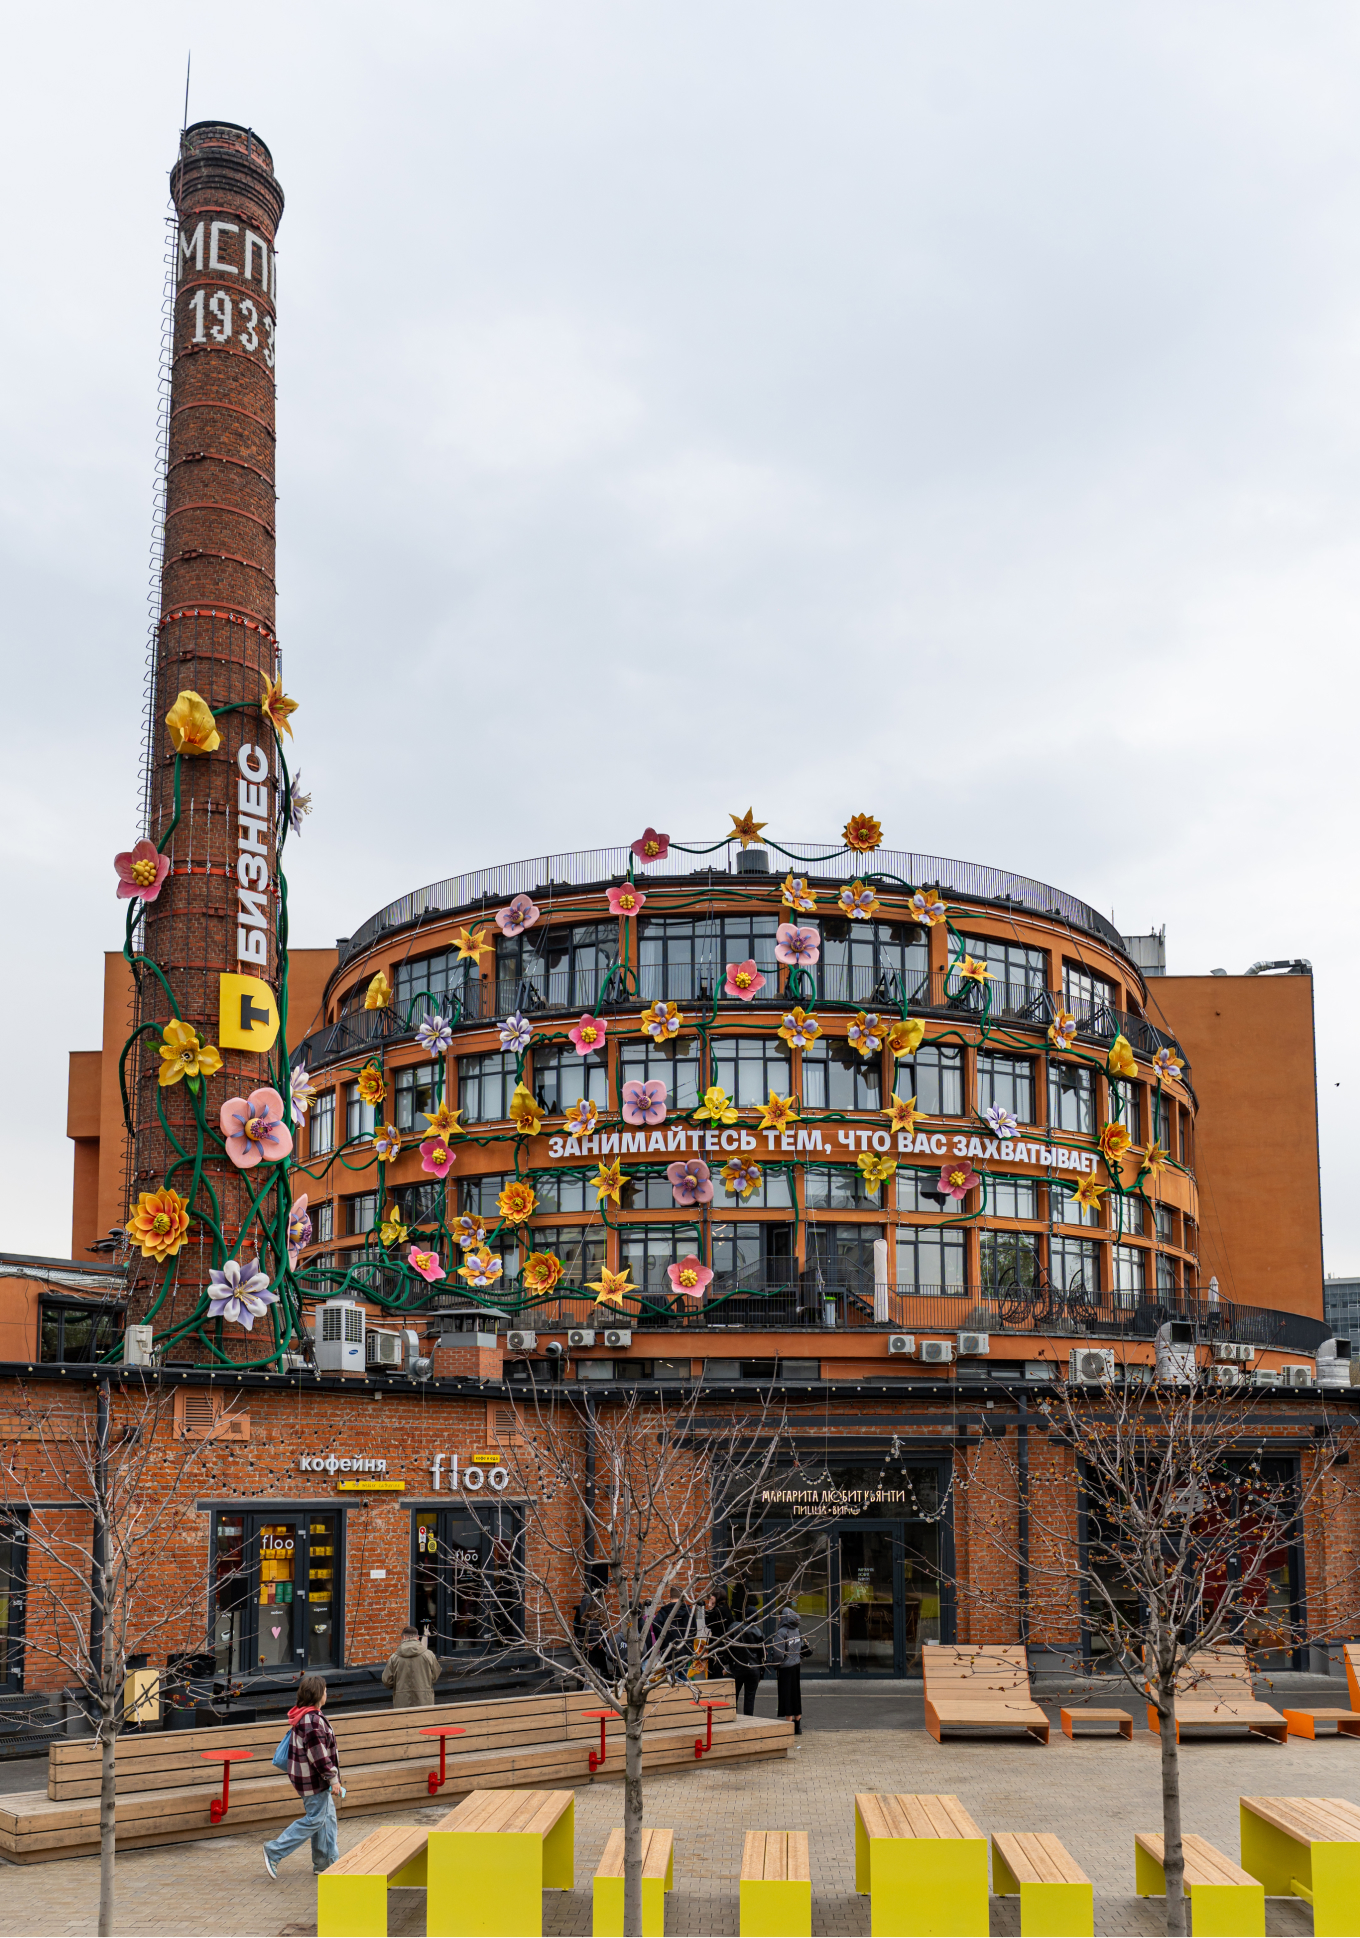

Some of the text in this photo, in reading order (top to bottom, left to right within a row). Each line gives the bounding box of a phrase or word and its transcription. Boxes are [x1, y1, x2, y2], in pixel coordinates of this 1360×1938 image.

[189, 289, 275, 368] 1933
[236, 743, 269, 966] БИЗНЕС
[548, 1126, 1101, 1174] ЗАНИМАЙТЕСЬ ТЕМ, ЧТО ВАС ЗАХВАТЫВАЕТ
[299, 1454, 387, 1475] кофейня
[430, 1453, 510, 1490] floo
[761, 1490, 819, 1503] МАРГАРИТА
[822, 1490, 863, 1503] ЛЮБИТ
[262, 1534, 294, 1550] floo
